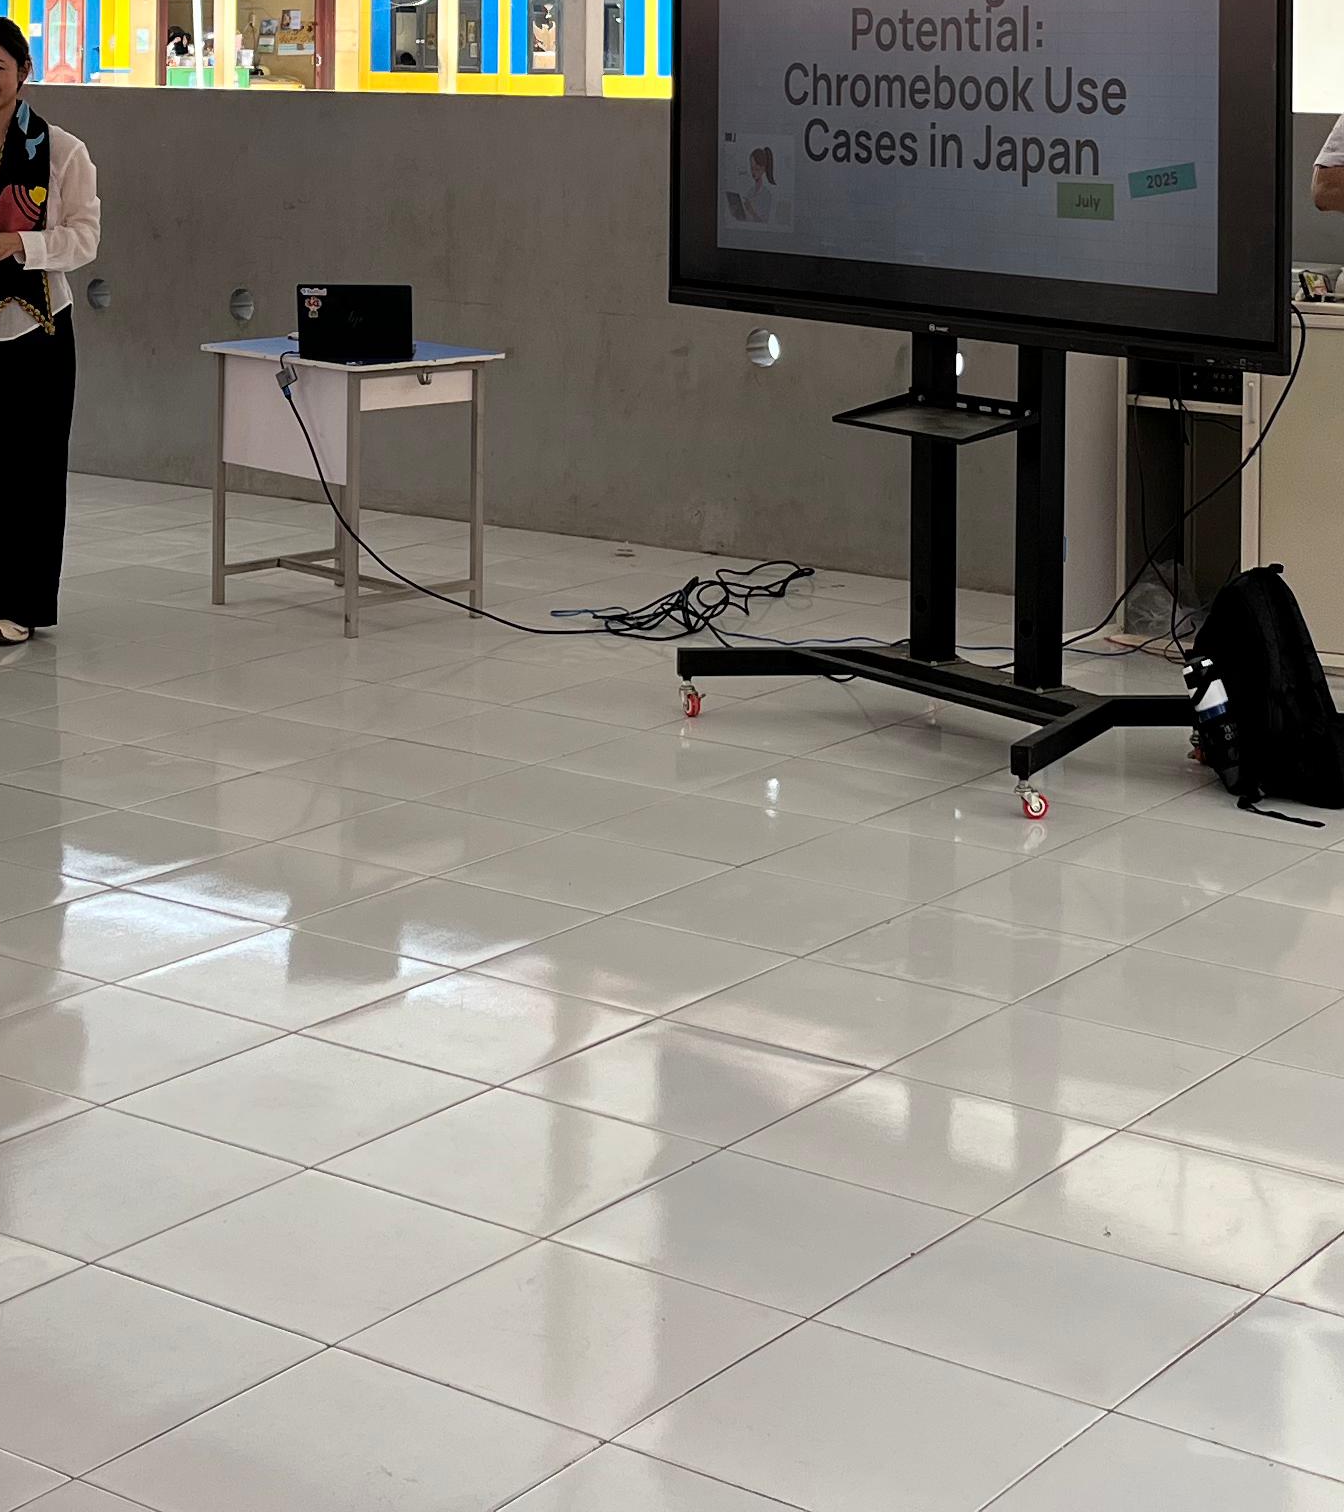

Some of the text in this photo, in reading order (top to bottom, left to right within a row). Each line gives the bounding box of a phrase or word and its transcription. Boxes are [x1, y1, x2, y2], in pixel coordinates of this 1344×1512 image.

[851, 4, 1045, 53] Potential:
[784, 62, 1128, 115] Chromebook Use
[803, 117, 1100, 187] Cases in Japan
[1075, 192, 1101, 211] July
[1146, 171, 1178, 189] 2025
